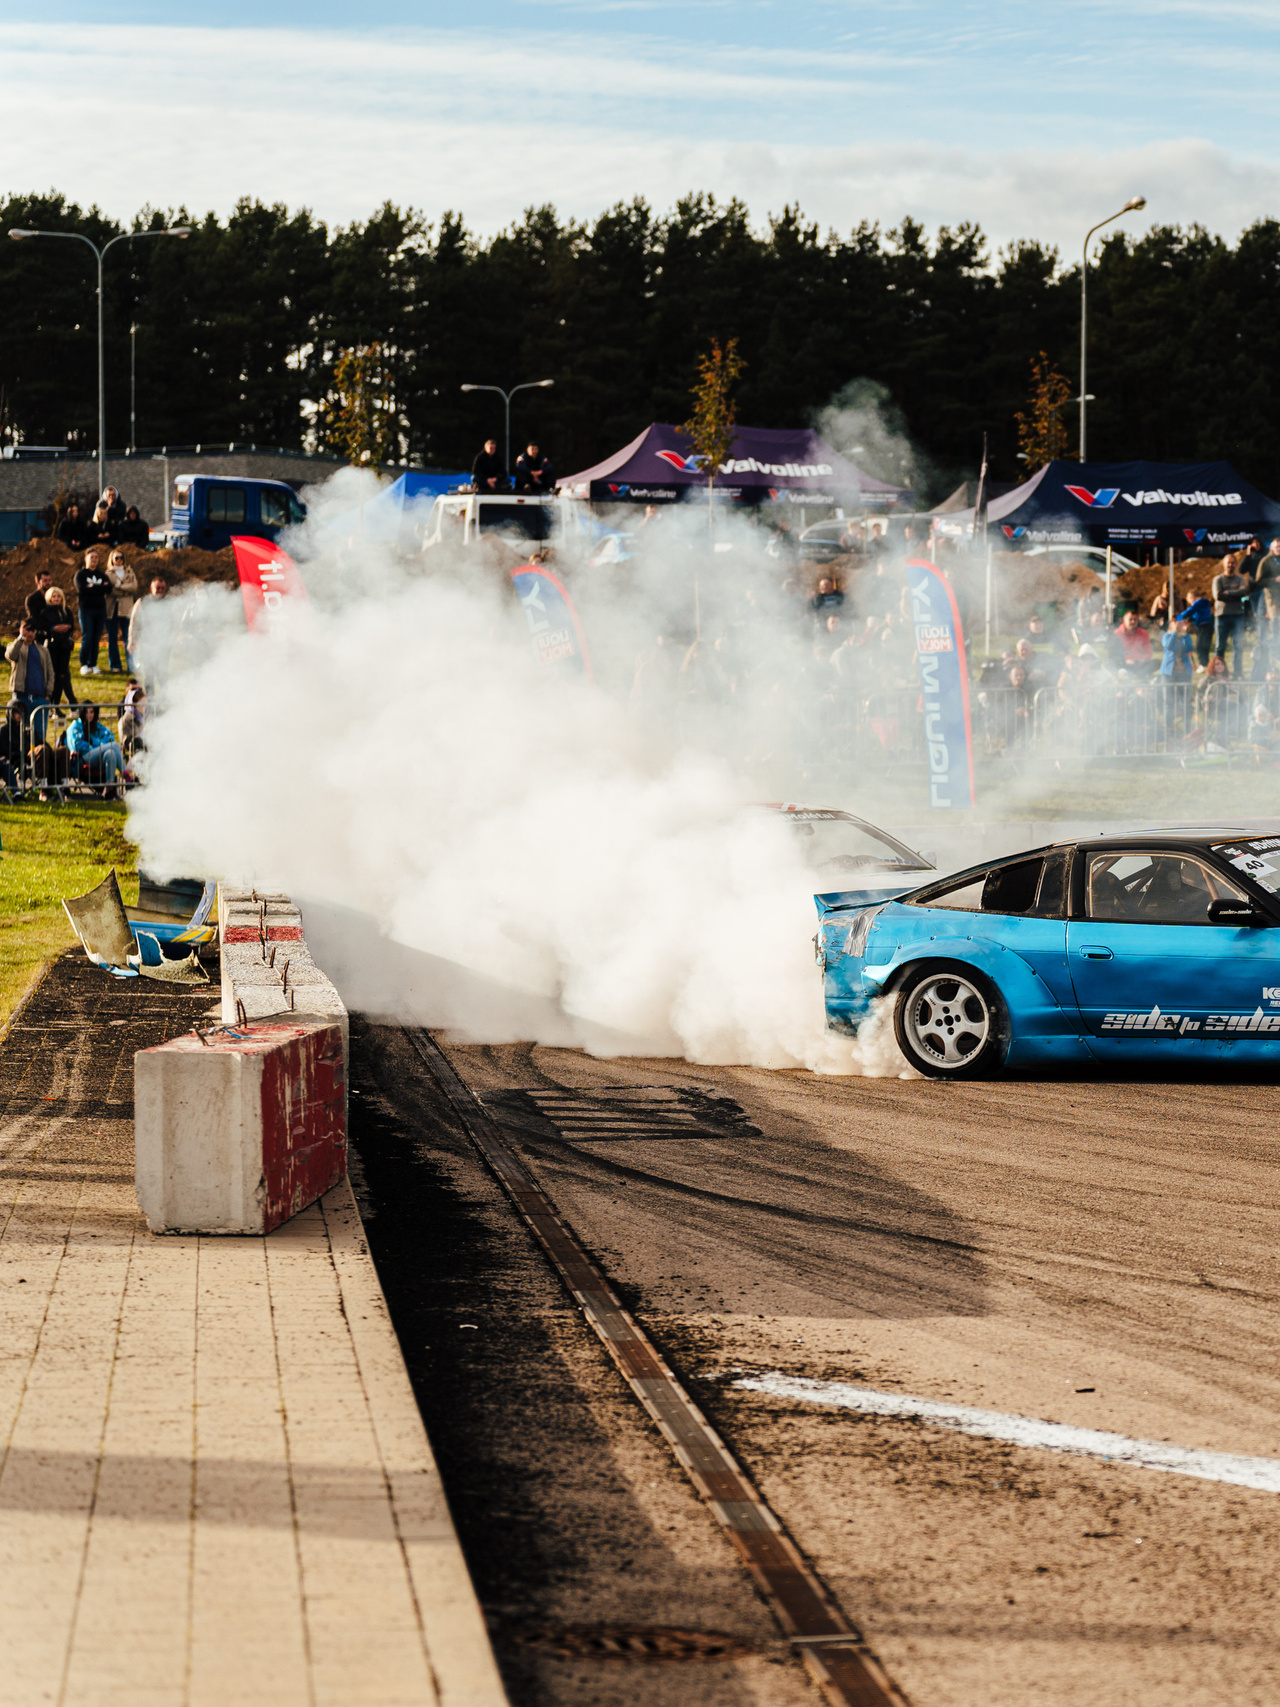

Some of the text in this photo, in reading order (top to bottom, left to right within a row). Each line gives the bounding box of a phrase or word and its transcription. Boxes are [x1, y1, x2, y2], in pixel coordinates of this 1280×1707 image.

[718, 456, 833, 477] Valvoline
[1121, 488, 1242, 507] Valvoline
[1027, 530, 1082, 543] Valvoline
[1207, 531, 1253, 543] Valvolin
[1245, 860, 1265, 870] 40
[1100, 1004, 1181, 1030] side
[1178, 1016, 1201, 1035] to
